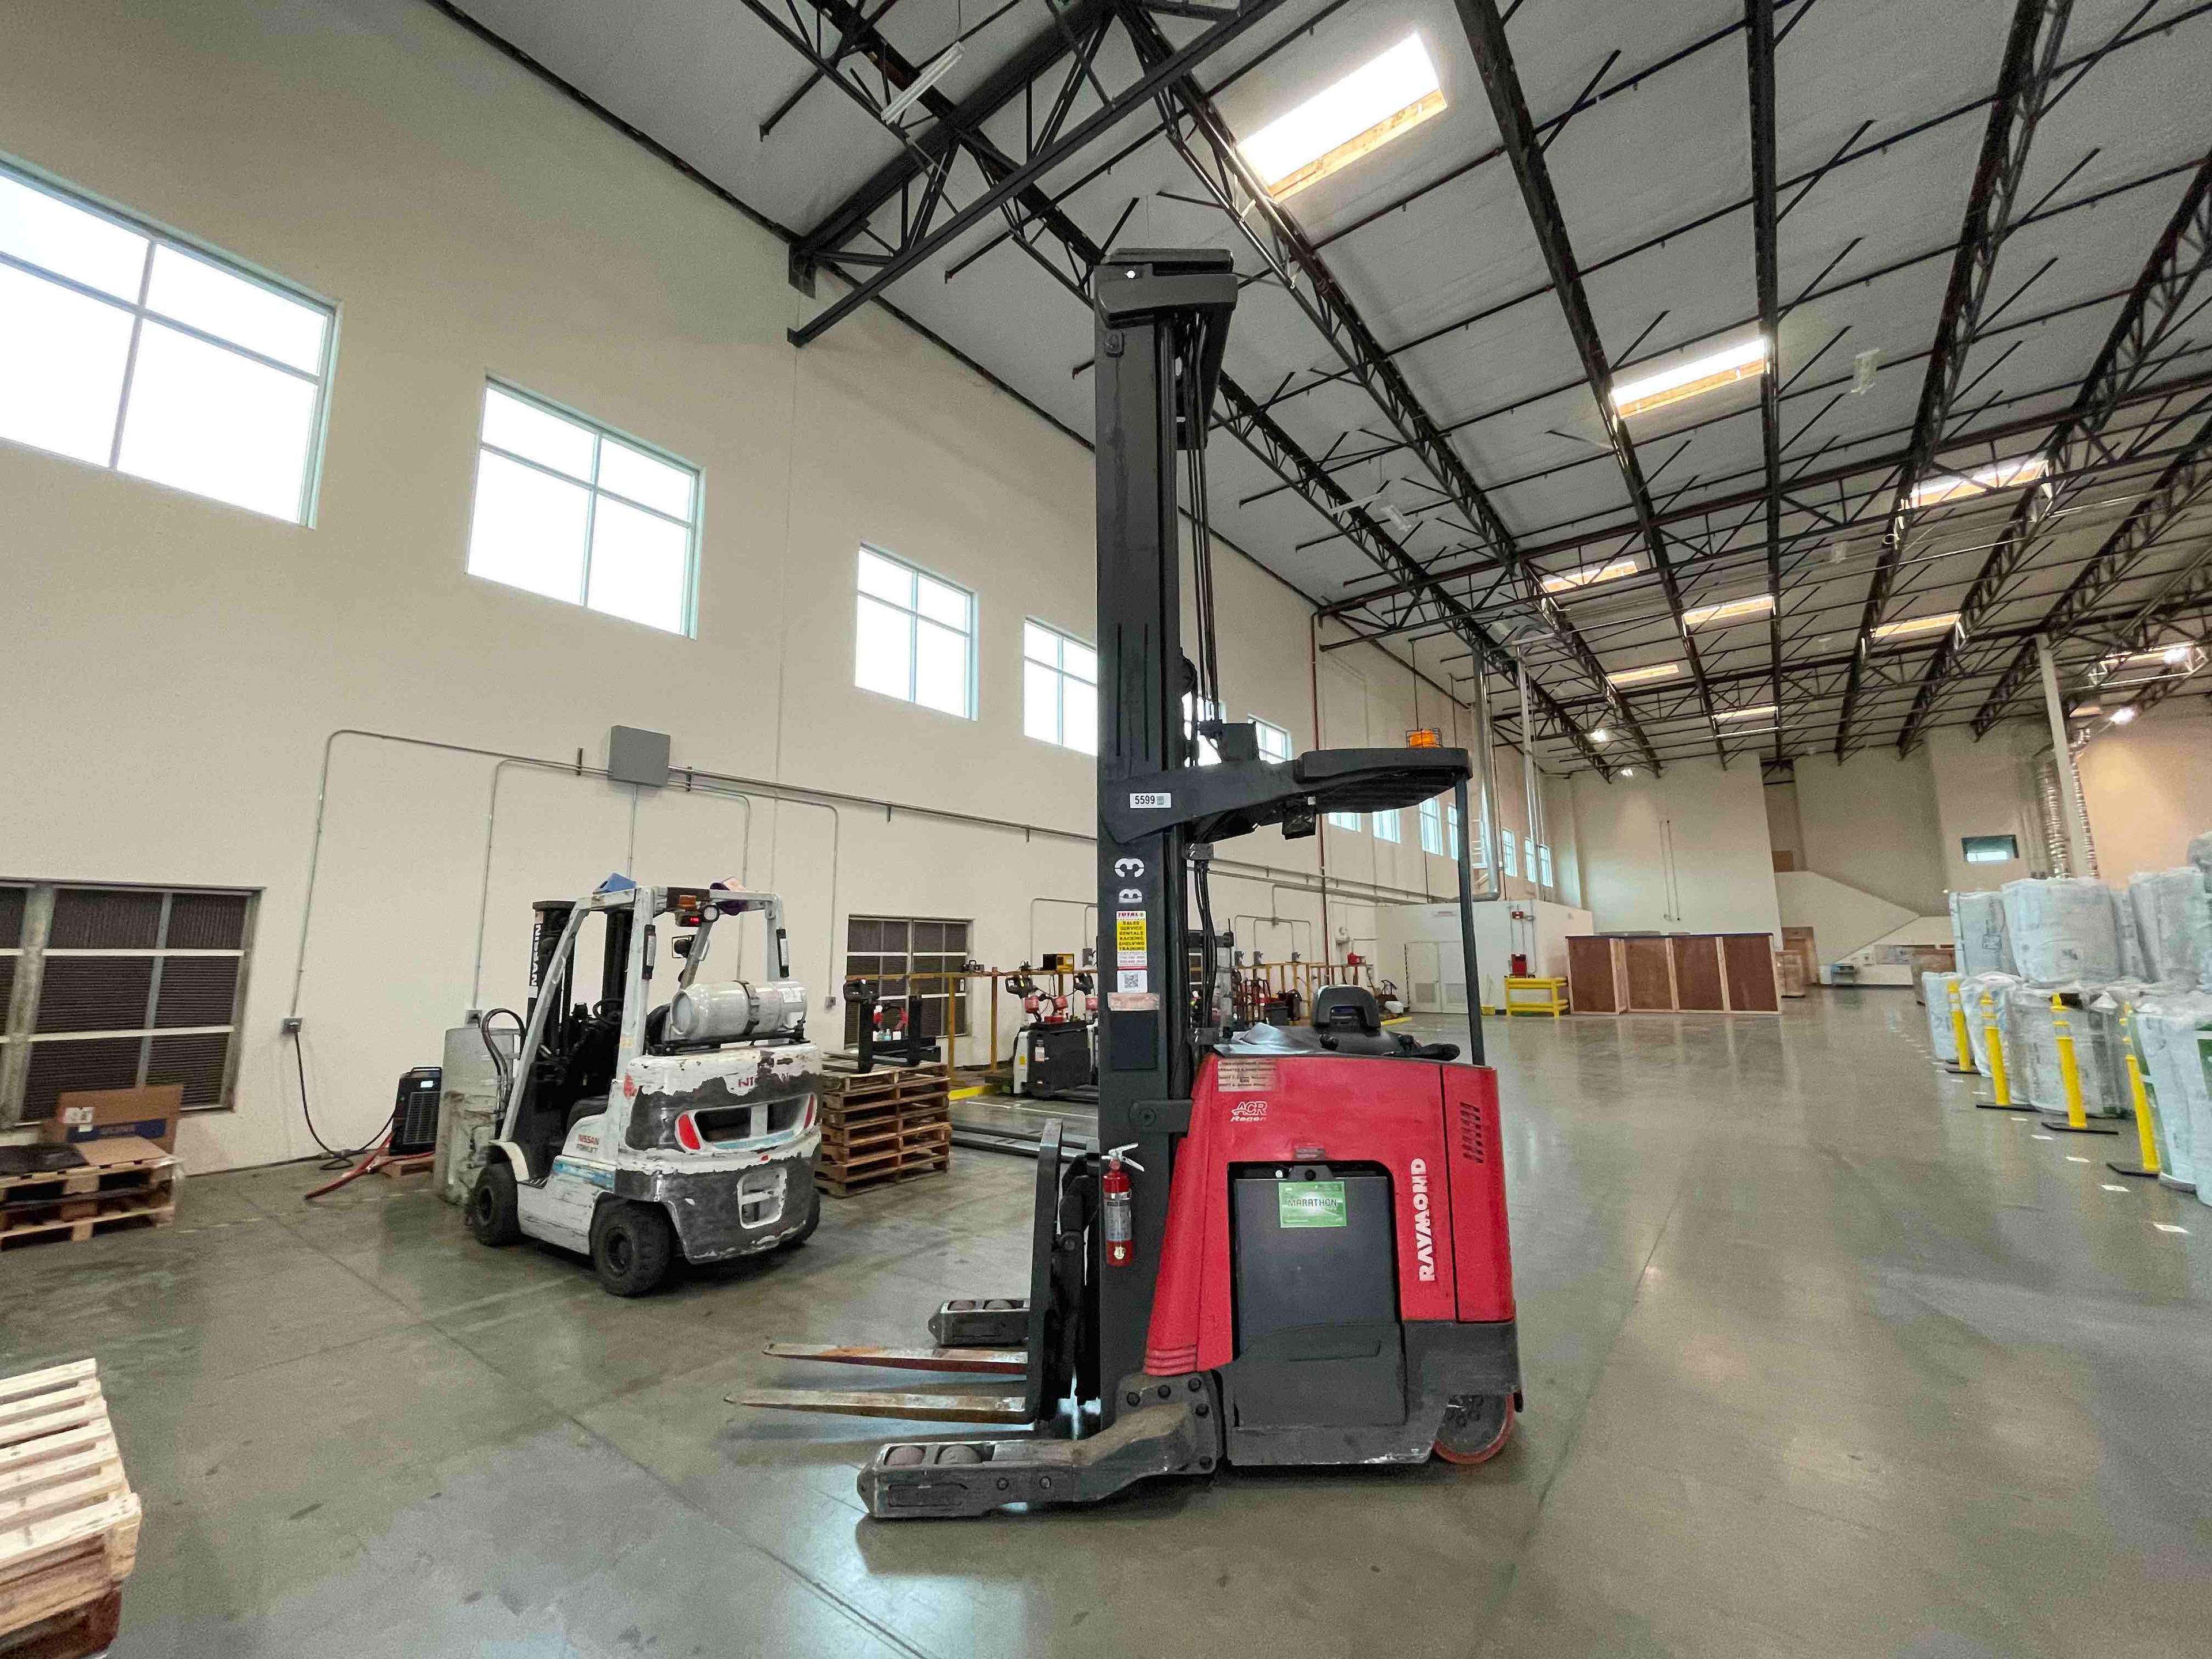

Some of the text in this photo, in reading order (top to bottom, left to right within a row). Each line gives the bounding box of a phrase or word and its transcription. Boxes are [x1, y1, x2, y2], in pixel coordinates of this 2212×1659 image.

[1135, 796, 1155, 805] 5599
[531, 924, 541, 986] NISSAN
[1232, 1101, 1267, 1116] ACR
[1289, 1198, 1337, 1207] MARATHON
[1411, 1158, 1435, 1282] RAYMOND
